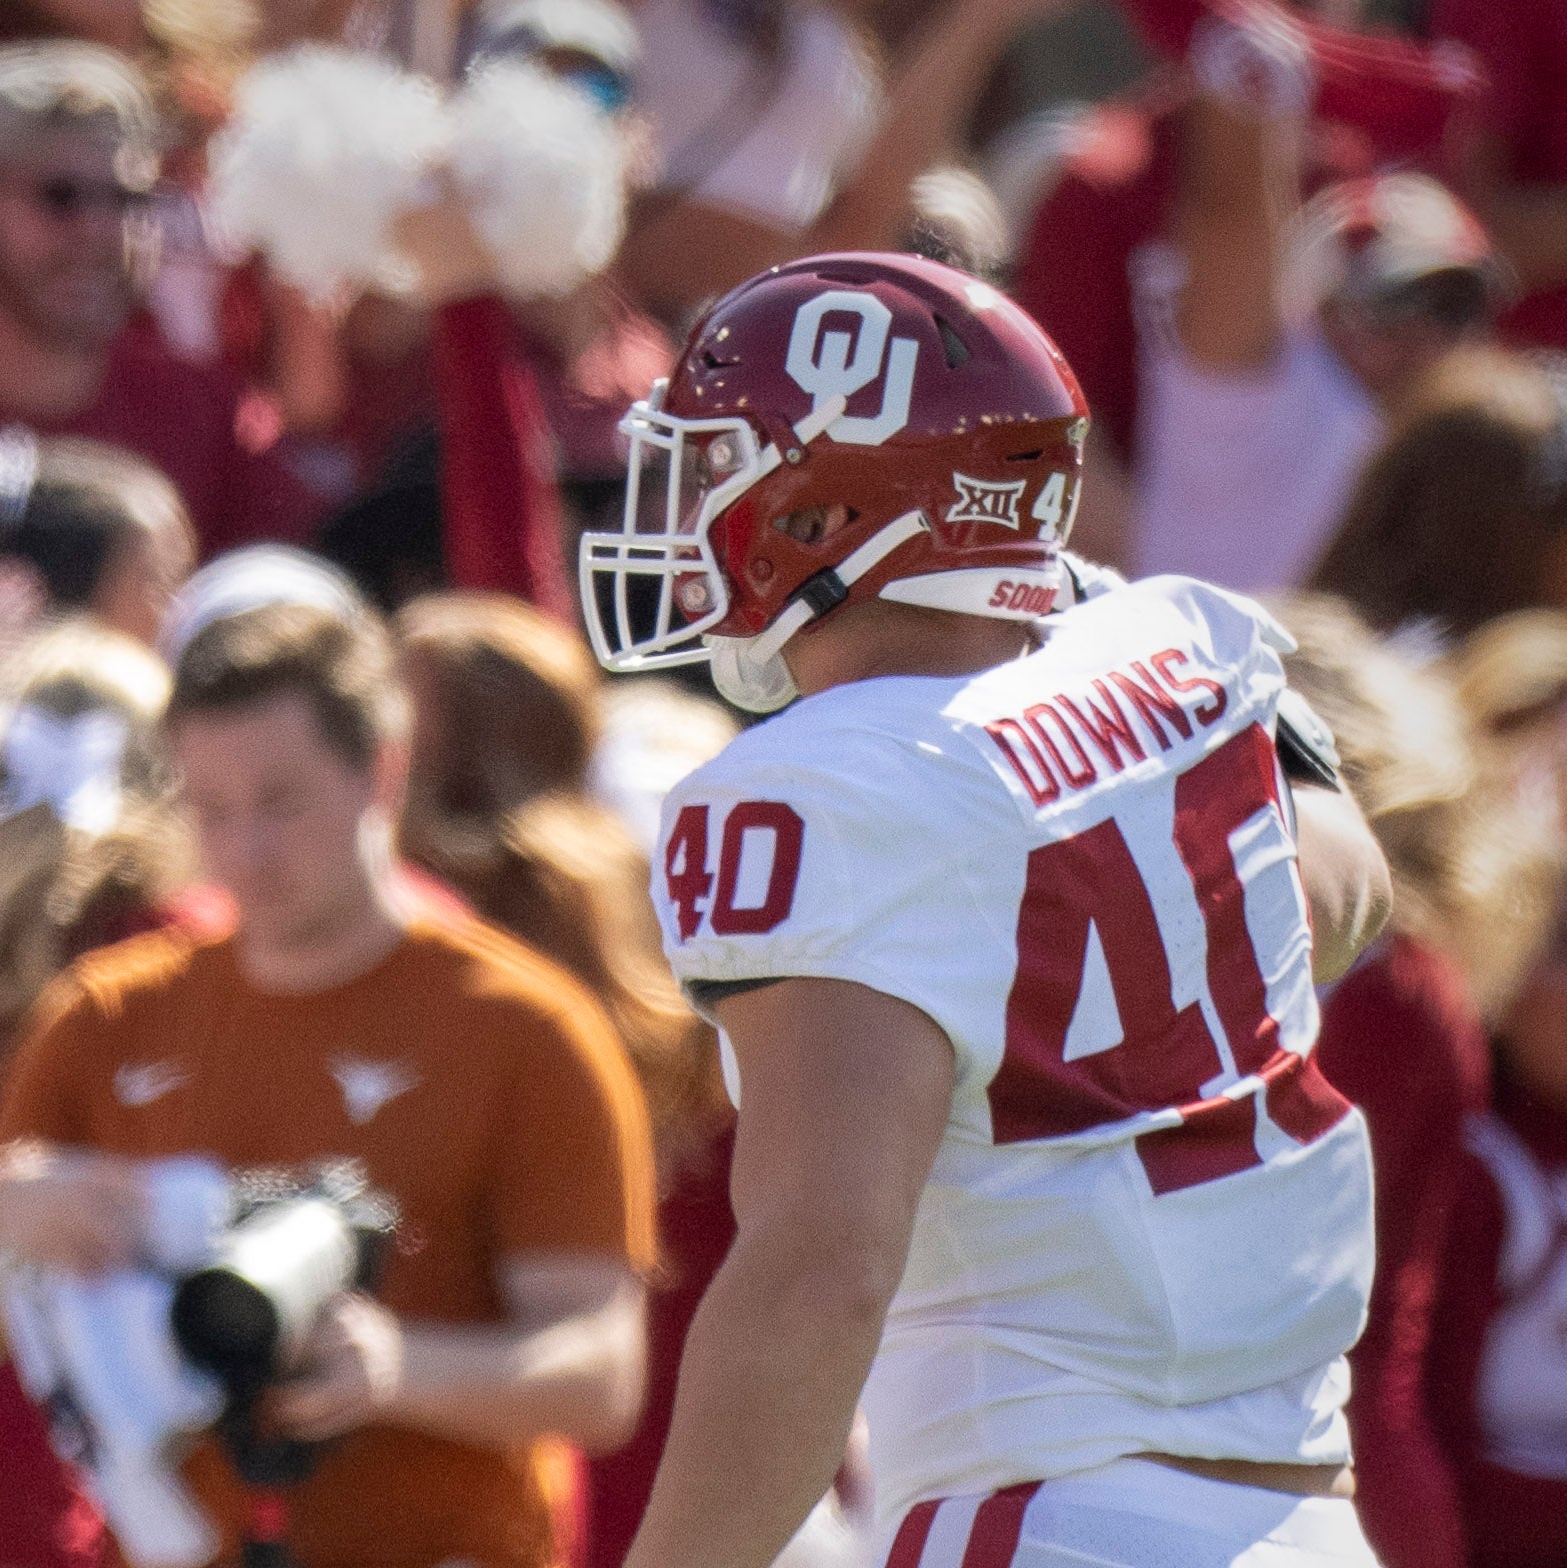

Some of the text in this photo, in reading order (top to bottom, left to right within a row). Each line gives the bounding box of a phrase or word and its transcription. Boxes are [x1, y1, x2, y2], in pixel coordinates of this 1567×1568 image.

[785, 290, 920, 446] OU
[1031, 472, 1066, 541] 4
[984, 648, 1228, 808] DOWNS
[665, 801, 805, 942] 40
